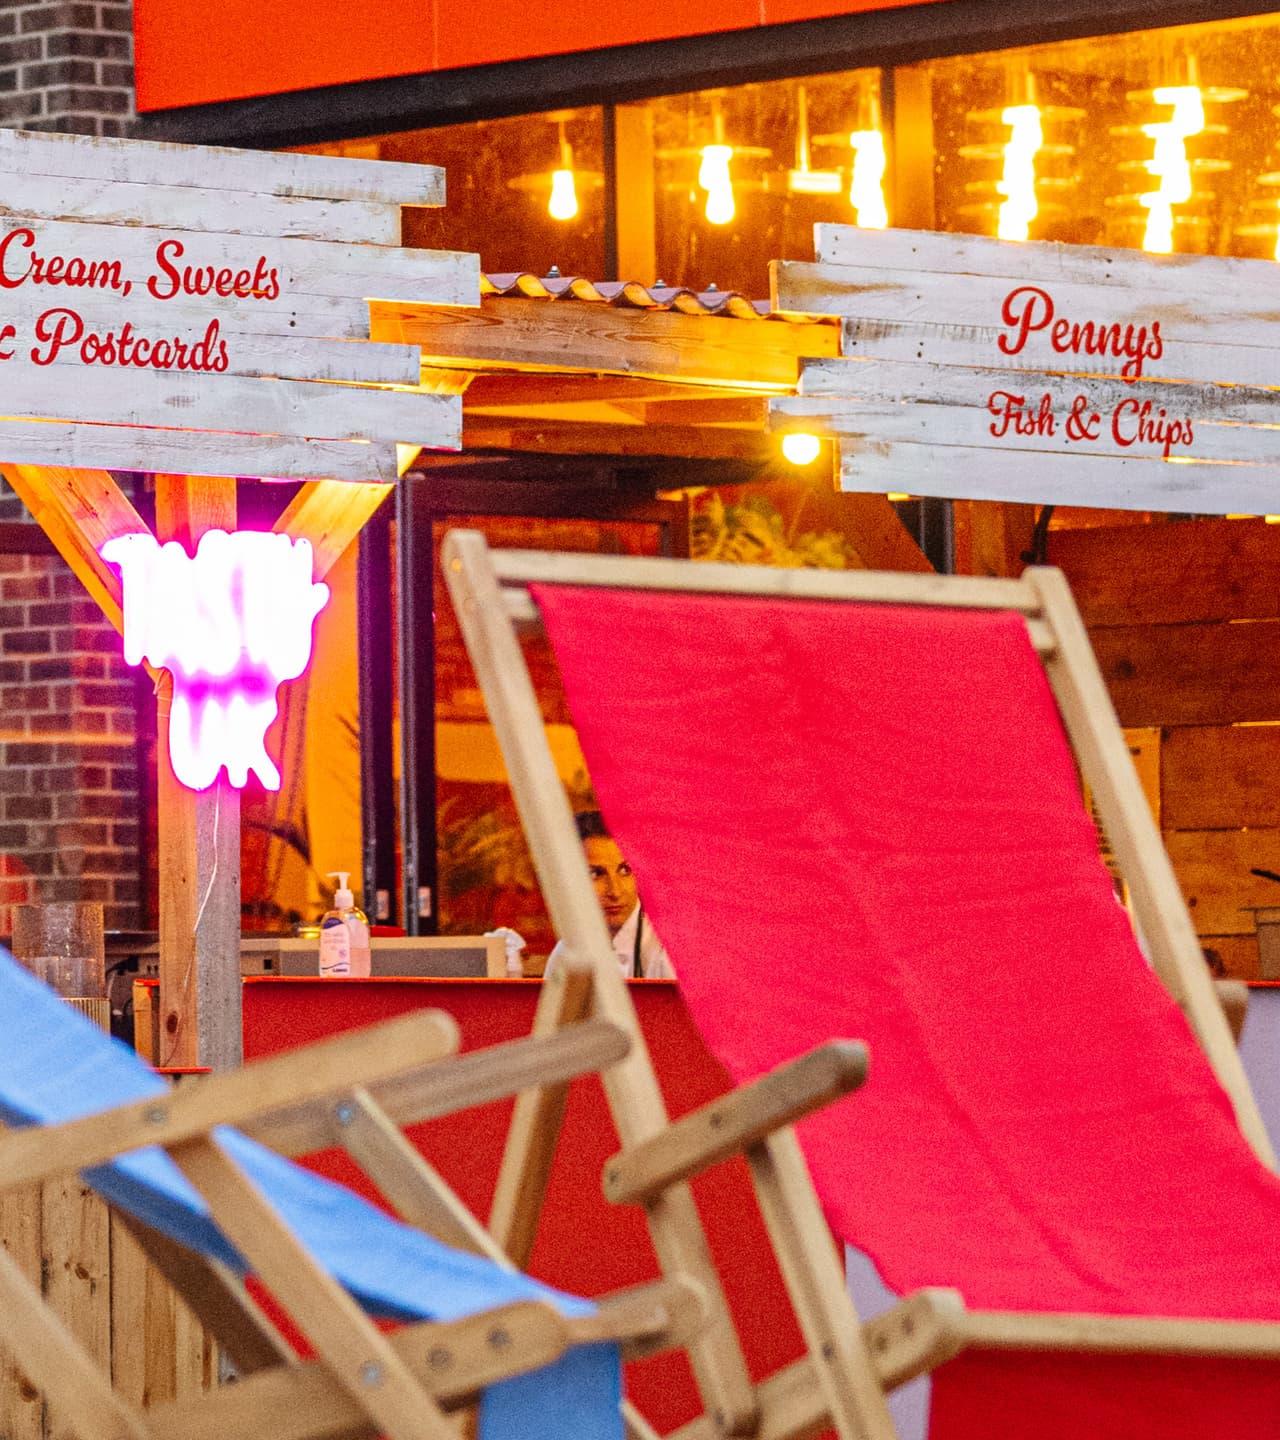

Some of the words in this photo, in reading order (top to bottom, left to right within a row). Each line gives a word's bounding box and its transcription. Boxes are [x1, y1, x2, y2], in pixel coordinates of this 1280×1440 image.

[147, 240, 279, 300] Sweets
[31, 308, 228, 372] Postcards
[998, 287, 1163, 384] Pennys
[988, 391, 1056, 439] Fish
[1066, 395, 1100, 442] &
[1111, 398, 1194, 459] Chips
